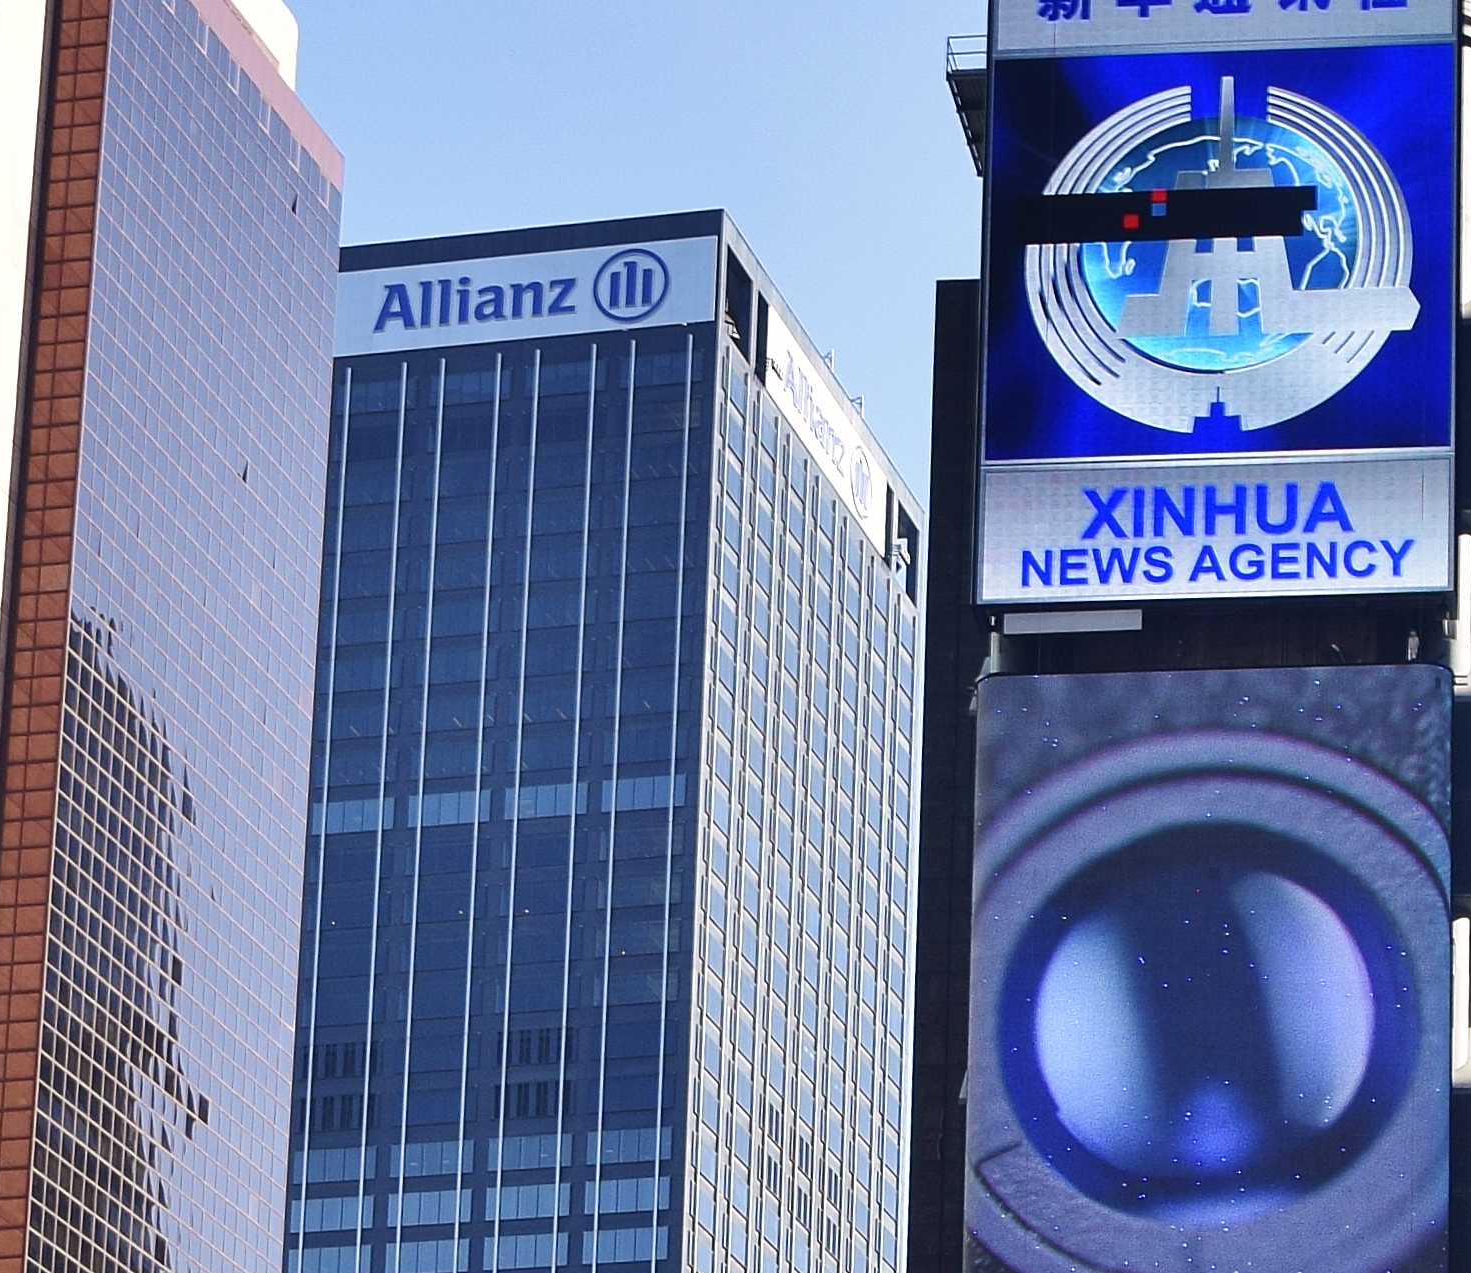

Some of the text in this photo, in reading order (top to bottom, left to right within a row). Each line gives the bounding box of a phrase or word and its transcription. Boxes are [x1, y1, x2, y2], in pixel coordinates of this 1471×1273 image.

[372, 277, 577, 334] Allianz
[1080, 481, 1354, 541] XINHUA
[1020, 538, 1416, 587] NEWS AGENCY
